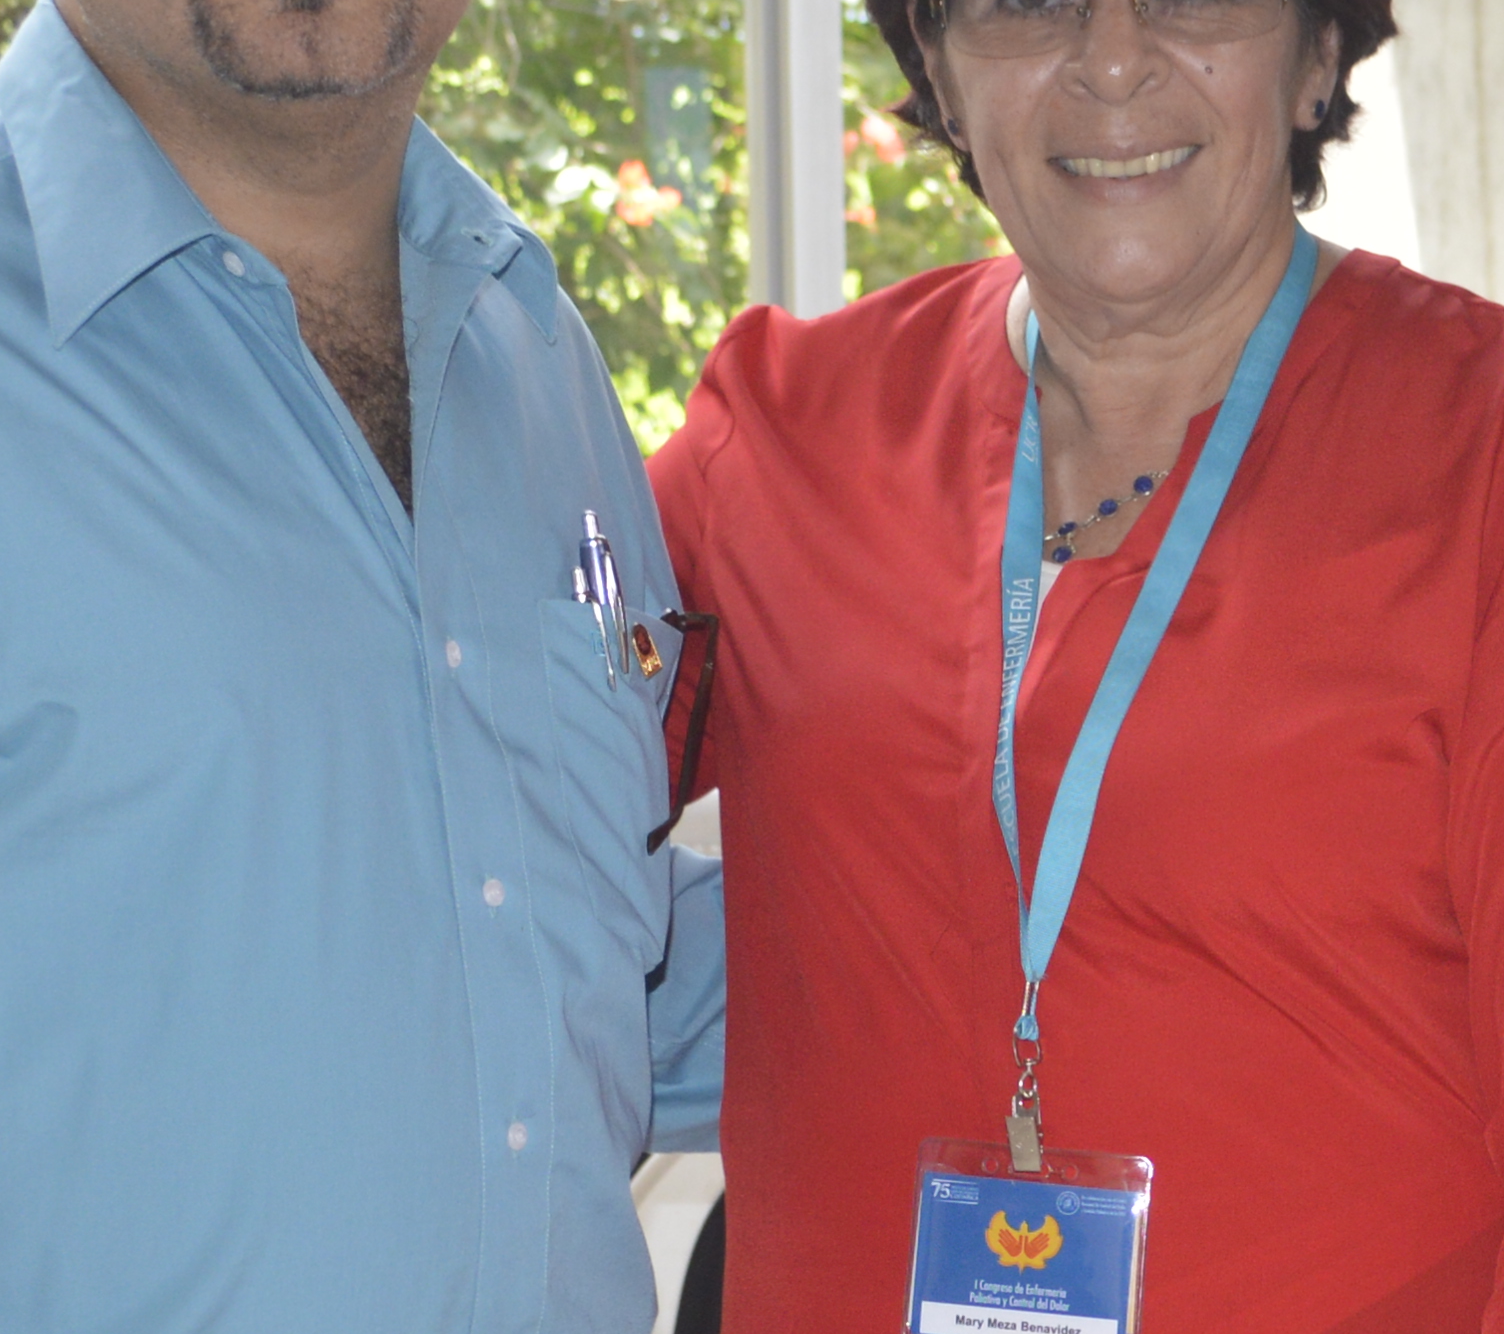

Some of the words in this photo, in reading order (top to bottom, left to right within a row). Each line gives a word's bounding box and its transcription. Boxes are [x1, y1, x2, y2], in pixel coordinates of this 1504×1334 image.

[1001, 578, 1034, 710] ENFERMERÍA
[994, 748, 1018, 855] CUELA
[931, 1181, 951, 1199] 75
[979, 1279, 1013, 1294] Congreso
[1014, 1282, 1024, 1294] de
[1009, 1296, 1035, 1309] Control
[1036, 1298, 1049, 1310] del
[1049, 1299, 1070, 1311] Dolor
[956, 1314, 984, 1330] Mary
[987, 1317, 1017, 1331] Meza
